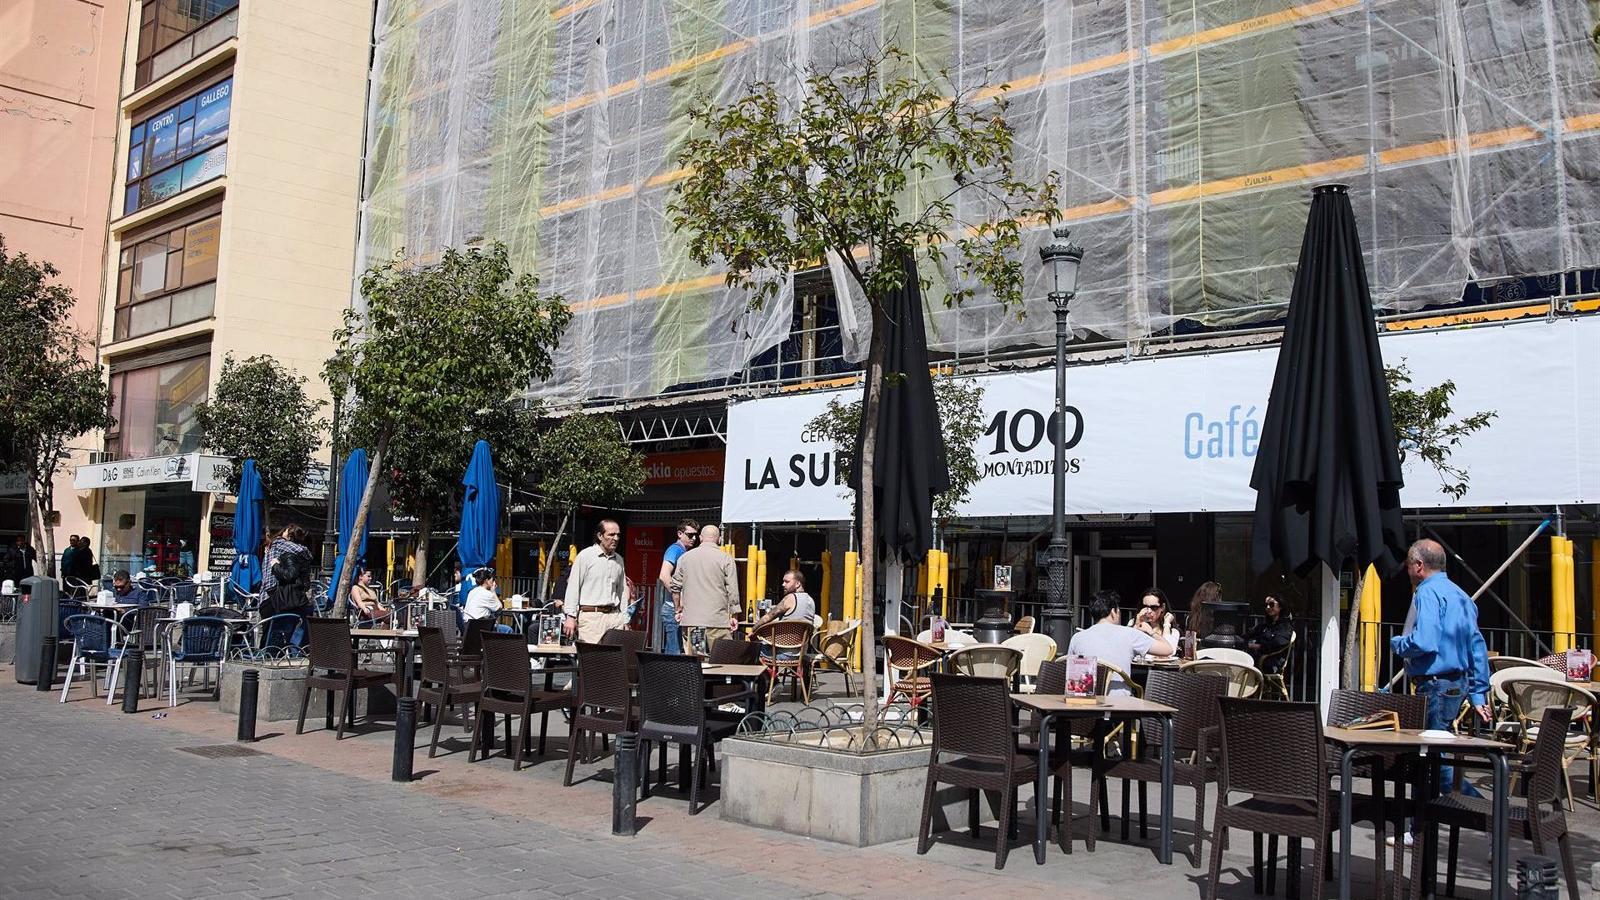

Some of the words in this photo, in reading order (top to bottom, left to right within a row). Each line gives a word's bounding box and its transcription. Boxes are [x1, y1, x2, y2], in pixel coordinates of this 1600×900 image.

[201, 84, 230, 107] GALLEGO
[152, 113, 174, 132] CENTRO
[801, 430, 834, 443] CERV
[984, 406, 1084, 455] 100
[1184, 405, 1258, 460] Café
[102, 467, 118, 482] D&G
[645, 463, 671, 479] ckia
[745, 457, 780, 490] LA
